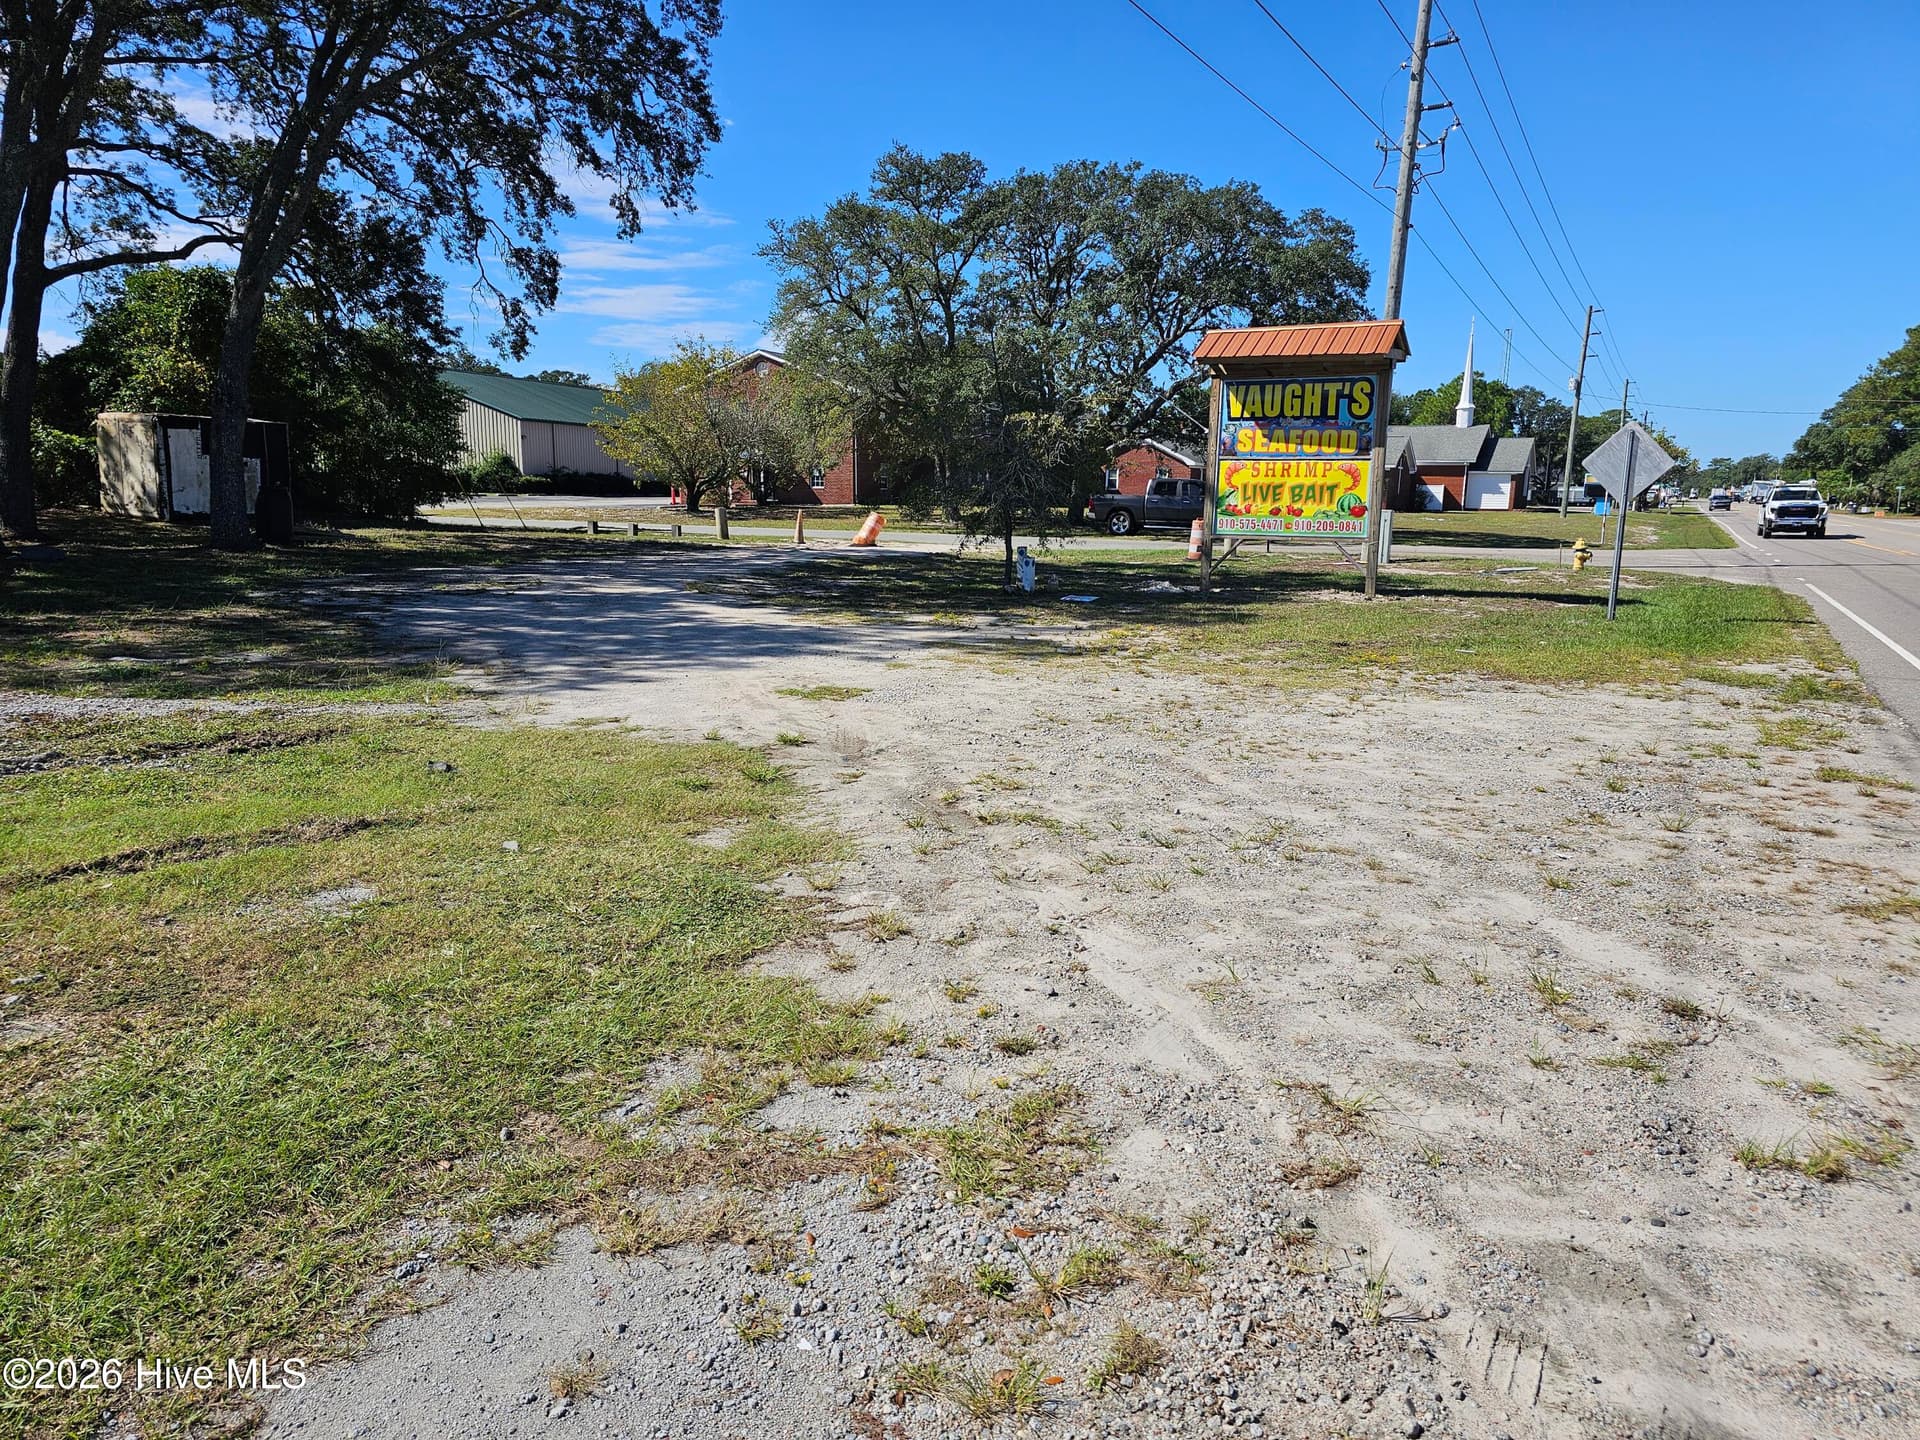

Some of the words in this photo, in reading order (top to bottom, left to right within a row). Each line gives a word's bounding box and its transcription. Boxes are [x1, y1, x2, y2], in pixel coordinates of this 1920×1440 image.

[1229, 381, 1371, 418] VAUGHT'S
[1237, 428, 1358, 454] SEAFOOD
[1251, 461, 1333, 478] SHRIMP
[1242, 482, 1282, 503] LIVE
[1289, 482, 1338, 504] BAIT
[1218, 518, 1283, 531] 910-575-4471
[1294, 519, 1363, 533] 910-209-0841
